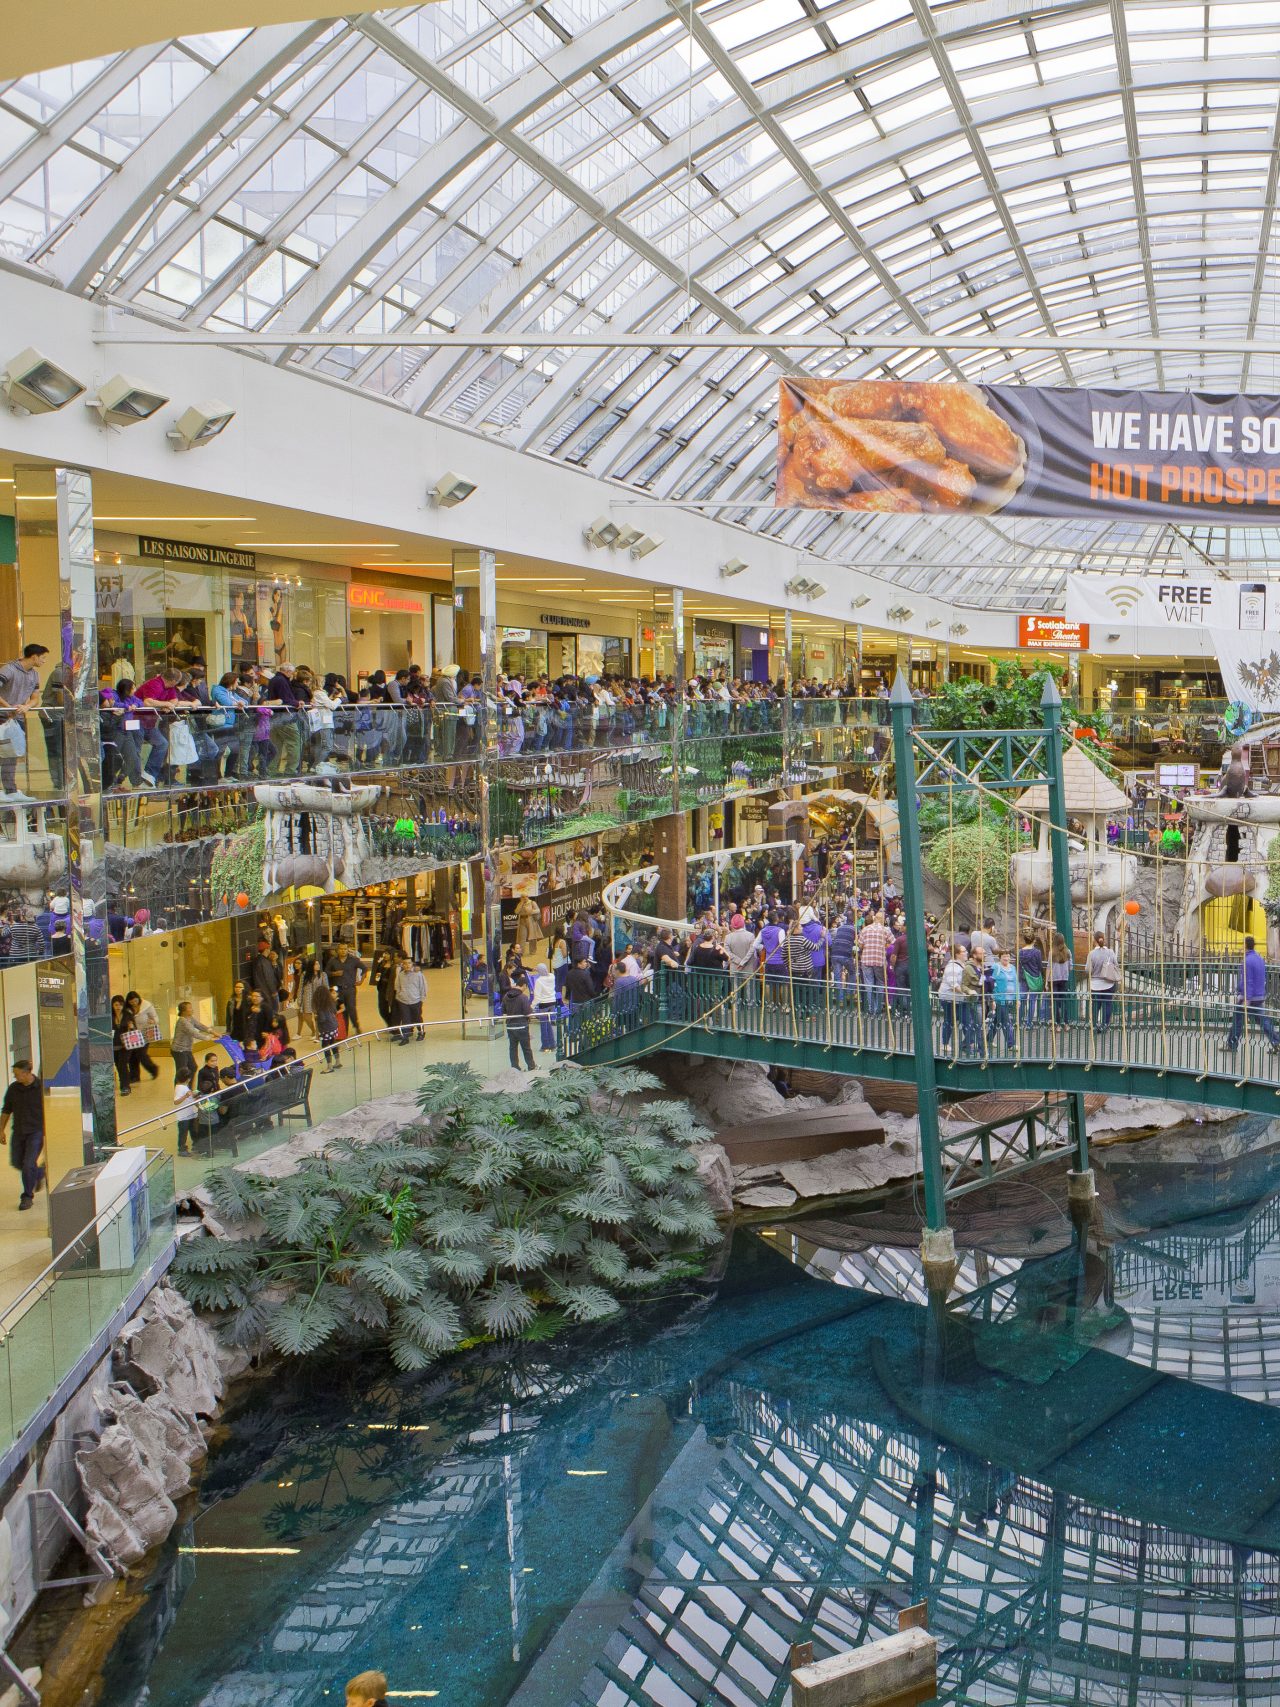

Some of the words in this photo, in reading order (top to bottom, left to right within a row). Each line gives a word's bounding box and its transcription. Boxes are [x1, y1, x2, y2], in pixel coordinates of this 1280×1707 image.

[1091, 411, 1140, 449] WE
[1149, 413, 1234, 454] HAVE
[1090, 463, 1154, 501] HOT
[143, 539, 165, 556] LES
[166, 542, 209, 562] SAISONS
[210, 548, 255, 568] LINGERIE
[350, 587, 385, 606] GNC
[1158, 585, 1213, 605] FREE
[1164, 605, 1205, 624] WIFI
[1037, 620, 1081, 630] Scotiabank
[1051, 629, 1081, 640] Theatre
[551, 900, 572, 923] HOUSE
[572, 897, 581, 911] OF
[581, 891, 601, 909] KNIVES
